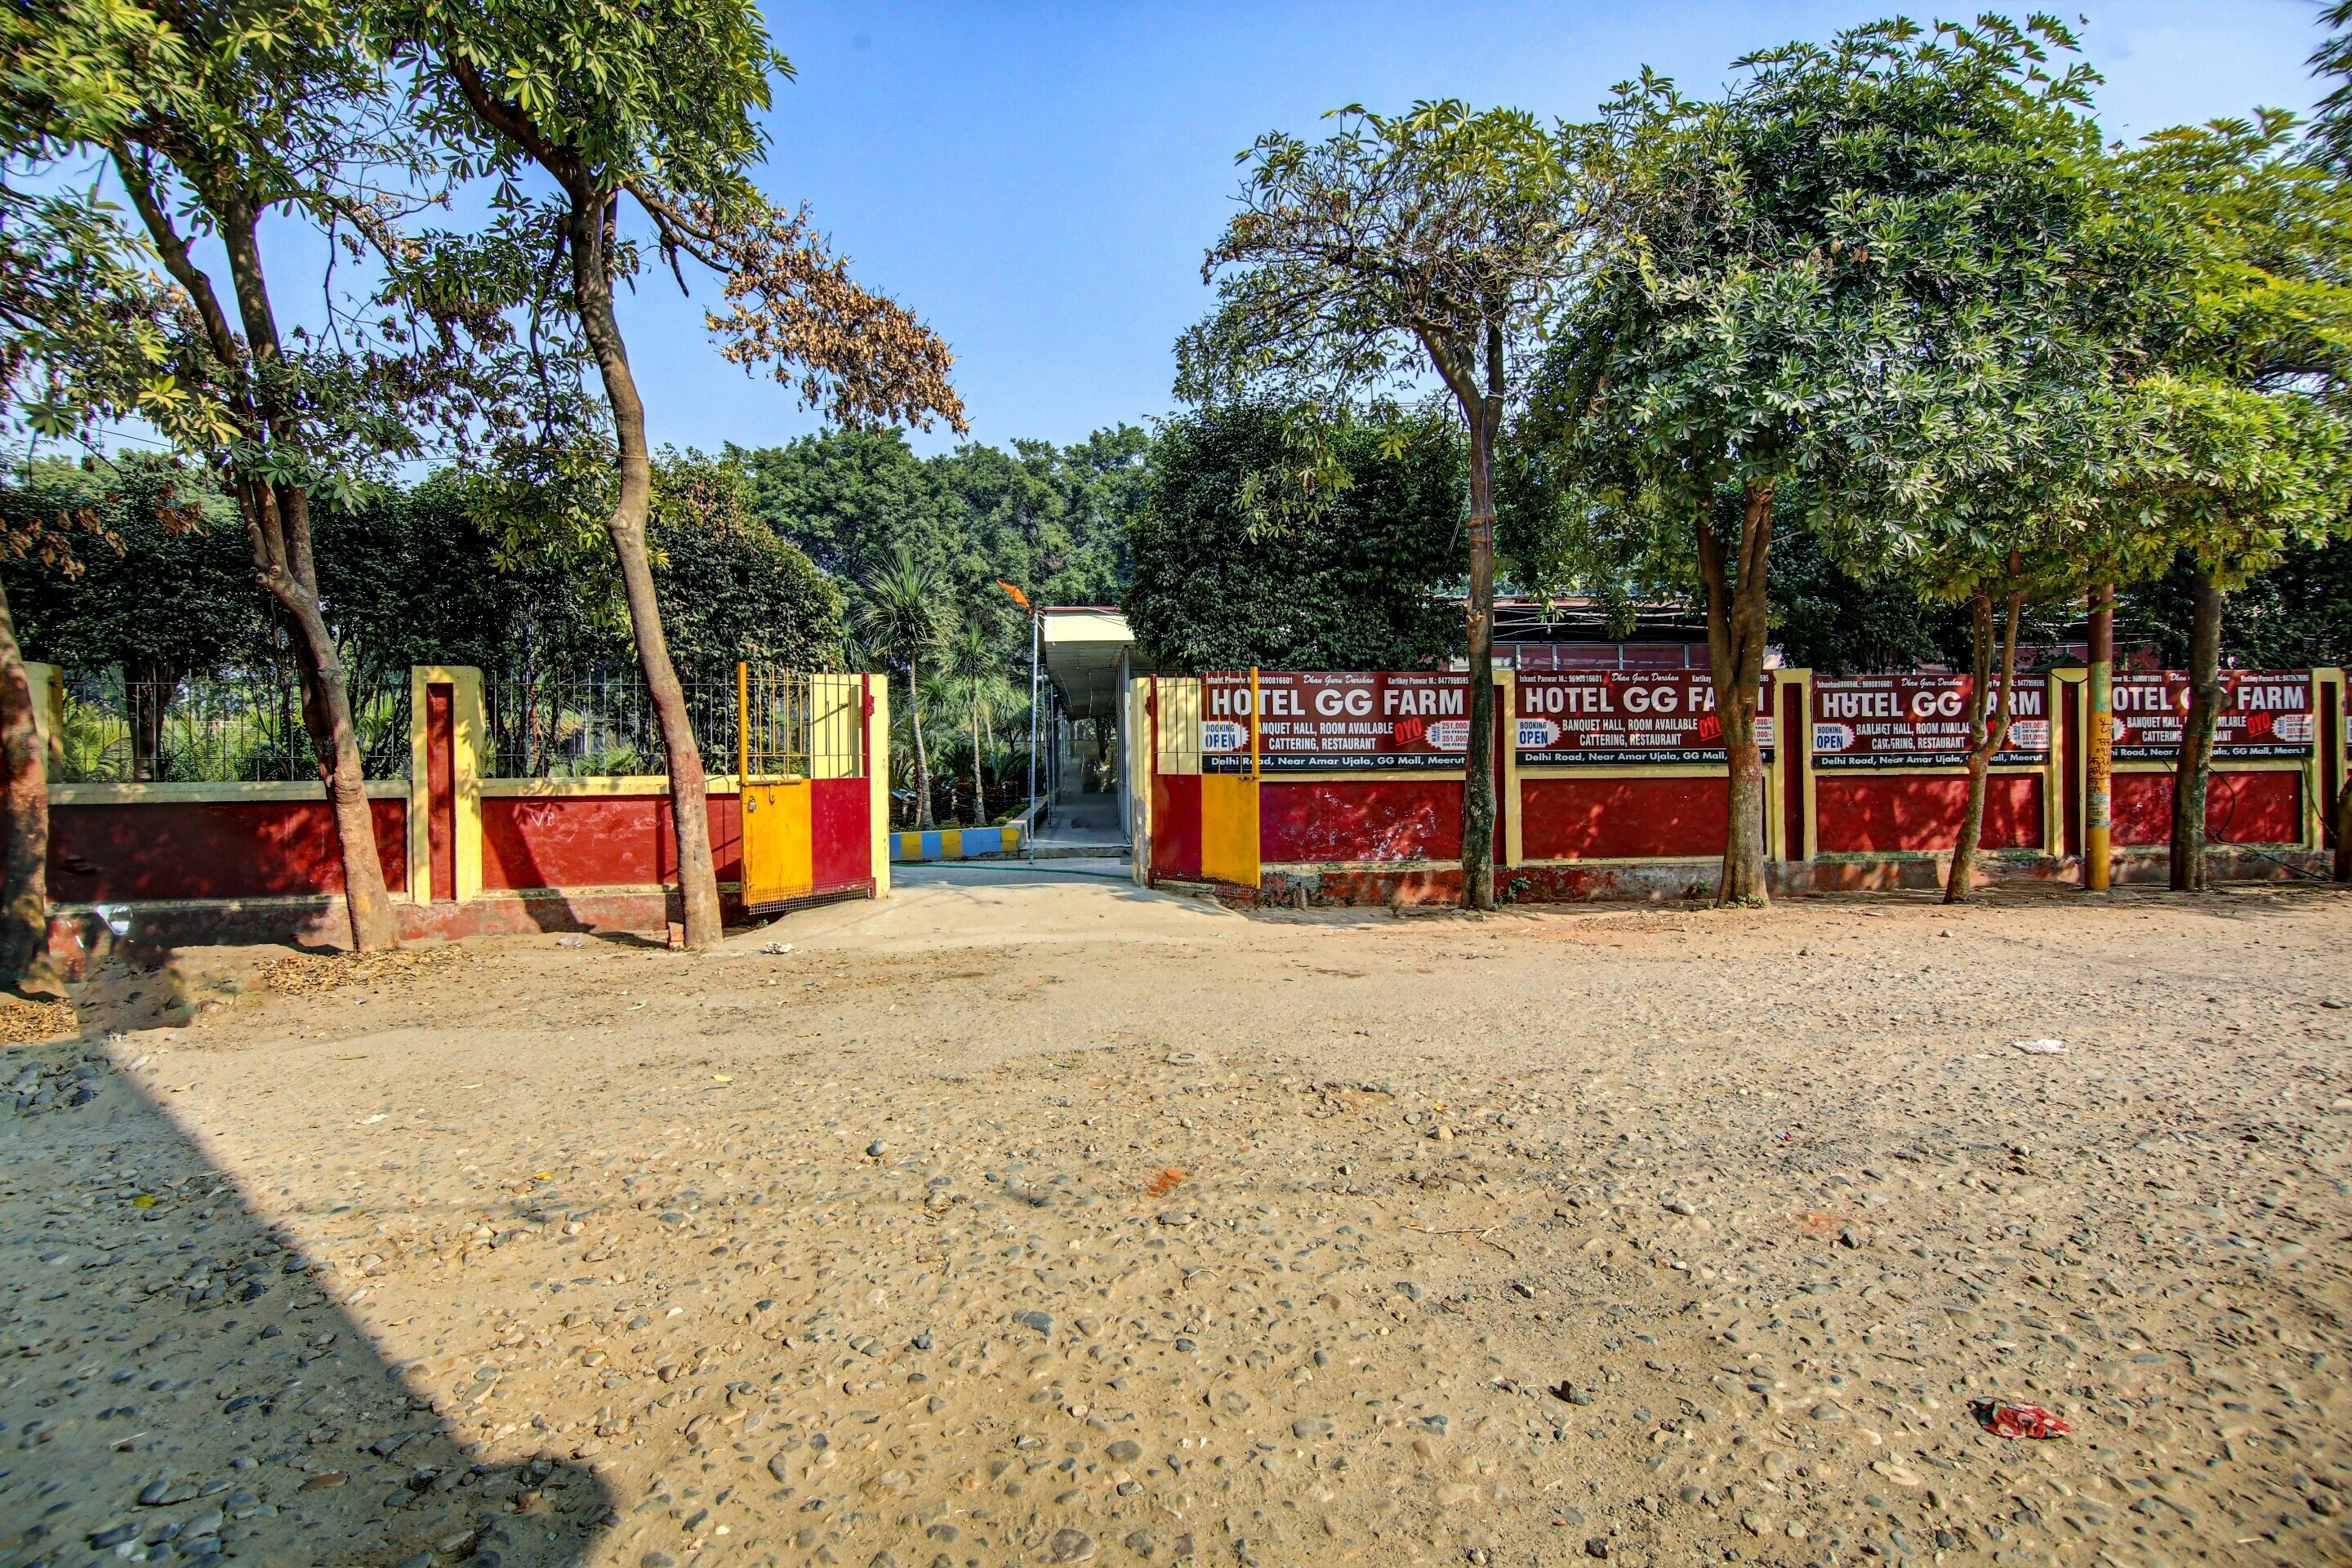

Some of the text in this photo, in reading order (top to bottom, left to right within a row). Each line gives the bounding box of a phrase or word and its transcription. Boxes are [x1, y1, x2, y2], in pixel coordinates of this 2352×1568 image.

[1303, 675, 1374, 686] Dhan Guru Darshan
[1388, 677, 1408, 686] Kartikey
[1519, 675, 1537, 683] Ishant
[1537, 675, 1557, 683] Panwar
[1568, 675, 1602, 683] 9690816601
[1612, 673, 1679, 684] Dhan Guru Darshan
[1692, 675, 1712, 684] Kartikey
[2169, 673, 2187, 681] Dhan
[1901, 678, 1963, 689] Dhan Guru Darshan
[1212, 689, 1463, 716] HOTEL GG FARM
[1526, 687, 1614, 713] HOTEL
[1623, 686, 1677, 713] GG
[1912, 691, 1962, 717] GG
[1984, 691, 2040, 715] ARM
[2112, 686, 2172, 710] OTEL
[2238, 686, 2305, 710] FARM
[1205, 724, 1235, 733] BOOKING
[1563, 719, 1698, 733] BANQUET HALL, ROOM AVAILABLE
[2127, 717, 2161, 728] BANQUET
[2163, 717, 2183, 729] HALL,
[2247, 712, 2270, 734] OYO
[1258, 722, 1393, 737] ANQUET HALL, ROOM AVAILABLE
[1395, 717, 1423, 742] OYO
[1893, 724, 1914, 737] HALL,
[1916, 723, 1939, 735] ROOM
[1205, 734, 1235, 748] OPEN
[1519, 731, 1548, 745] OPEN
[1579, 733, 1682, 748] CATTERING, RESTAURANT
[1816, 735, 1842, 748] OPEN
[1918, 737, 1965, 749] RESTAURANT
[1269, 738, 1376, 751] CATTERING, RESTAURANT
[1526, 753, 1552, 761] Delhi
[1555, 753, 1585, 761] Road,
[1589, 753, 1615, 761] Near
[1650, 752, 1680, 762] Ujala,
[1683, 751, 1699, 760] GG
[1702, 751, 1728, 761] Mall,
[2121, 748, 2148, 756] Road,
[2249, 747, 2272, 756] Mall,
[1243, 758, 1274, 766] Rad,
[1343, 756, 1374, 767] Ujala,
[1398, 756, 1424, 766] Mall,
[1428, 756, 1465, 764] Meerut
[1821, 756, 1846, 765] Delhi
[1849, 756, 1877, 766] Road,
[1880, 756, 1904, 764] Near
[1906, 756, 1933, 764] Amar
[1936, 755, 1963, 764] Ujala,
